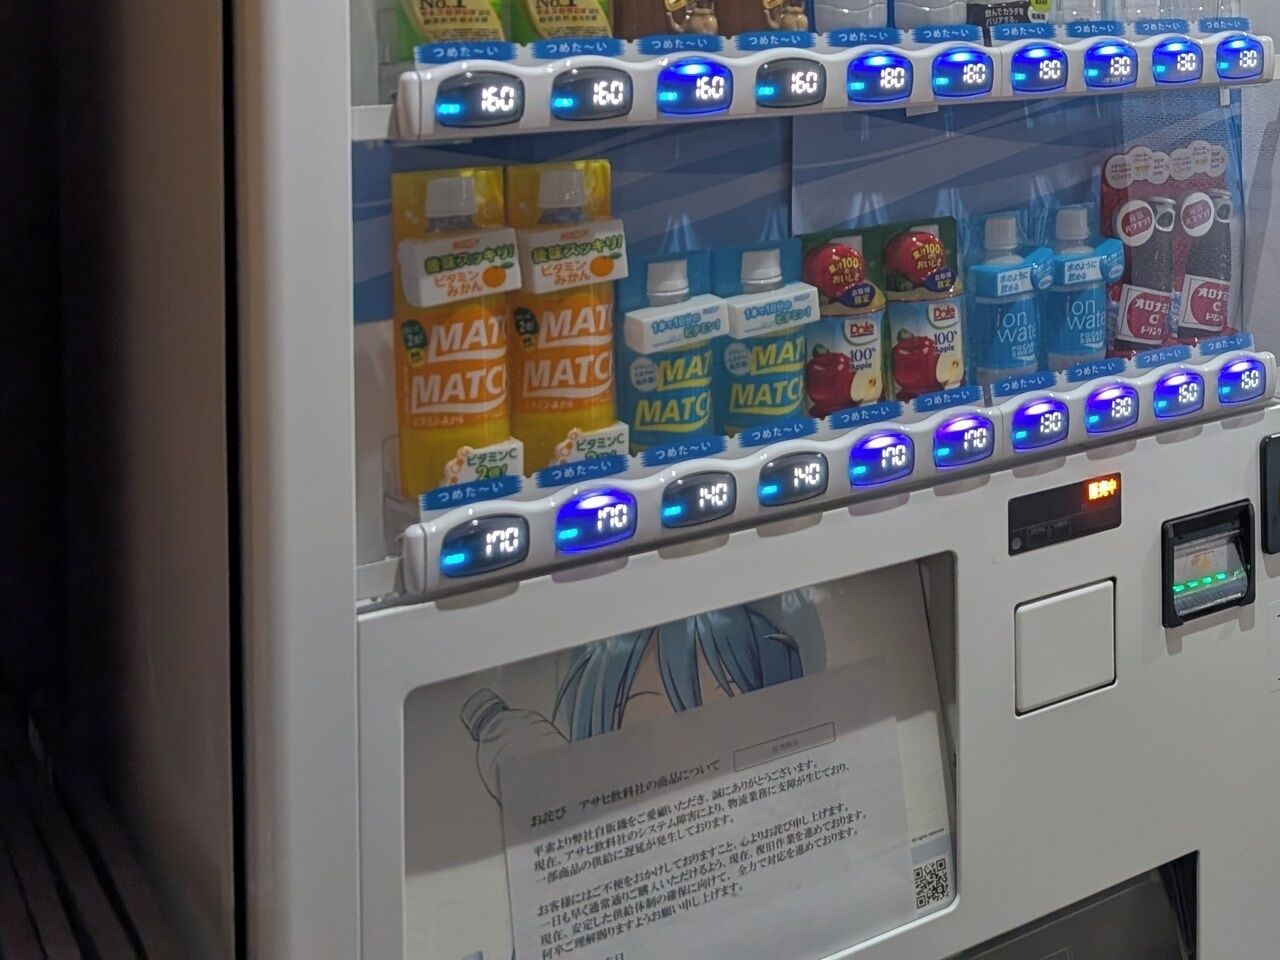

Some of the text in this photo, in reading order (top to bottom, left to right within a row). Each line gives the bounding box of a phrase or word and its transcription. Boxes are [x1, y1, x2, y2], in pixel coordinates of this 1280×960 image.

[1109, 56, 1130, 75] 130
[1176, 53, 1196, 71] 130
[1239, 50, 1257, 68] 130
[1039, 60, 1061, 79] 190
[695, 76, 724, 101] 160
[791, 71, 818, 94] 160
[481, 85, 515, 112] 160
[592, 80, 624, 106] 160
[541, 260, 586, 276] ビタミン
[1067, 261, 1097, 272] 水のように
[435, 271, 480, 287] ビタミン
[554, 271, 591, 286] みかん
[447, 282, 482, 297] みかん
[934, 306, 955, 318] Dole
[1066, 296, 1095, 315] ion
[997, 308, 1026, 327] ion
[851, 322, 874, 335] Dole
[1140, 325, 1162, 336] ドリンク
[935, 344, 954, 353] Apple
[851, 362, 872, 370] Apple
[1240, 369, 1259, 389] 150
[1178, 383, 1198, 403] 150
[1110, 397, 1132, 418] 130
[1039, 412, 1061, 433] 130
[576, 434, 624, 451] ビタミンC
[467, 448, 518, 465] ビタミンC
[794, 463, 821, 486] 140
[699, 483, 728, 508] 140
[579, 759, 721, 810] アサヒ飲料社の商品について
